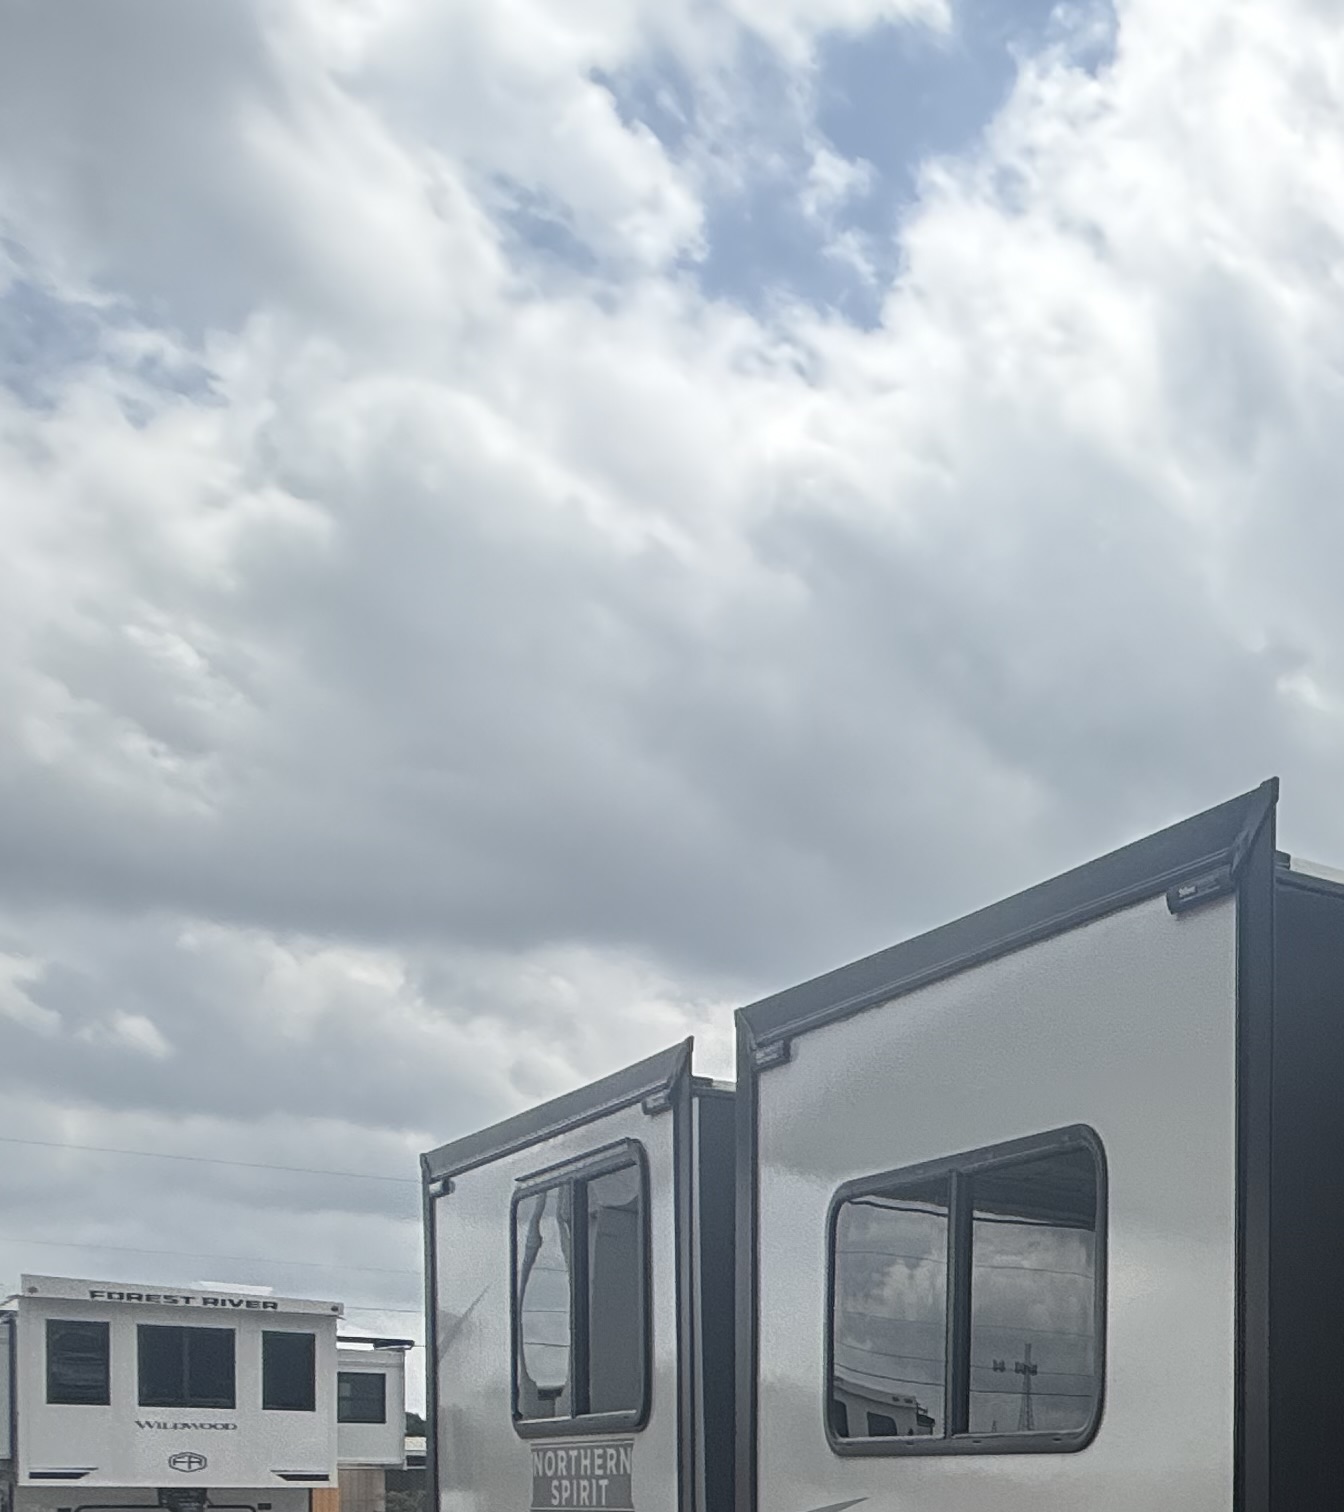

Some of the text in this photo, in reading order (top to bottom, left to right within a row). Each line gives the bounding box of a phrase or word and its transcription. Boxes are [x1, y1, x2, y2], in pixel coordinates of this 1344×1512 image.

[89, 1290, 278, 1310] FOREST RIVER
[532, 1447, 632, 1477] NORTHERN
[551, 1479, 609, 1506] SPIRIT
